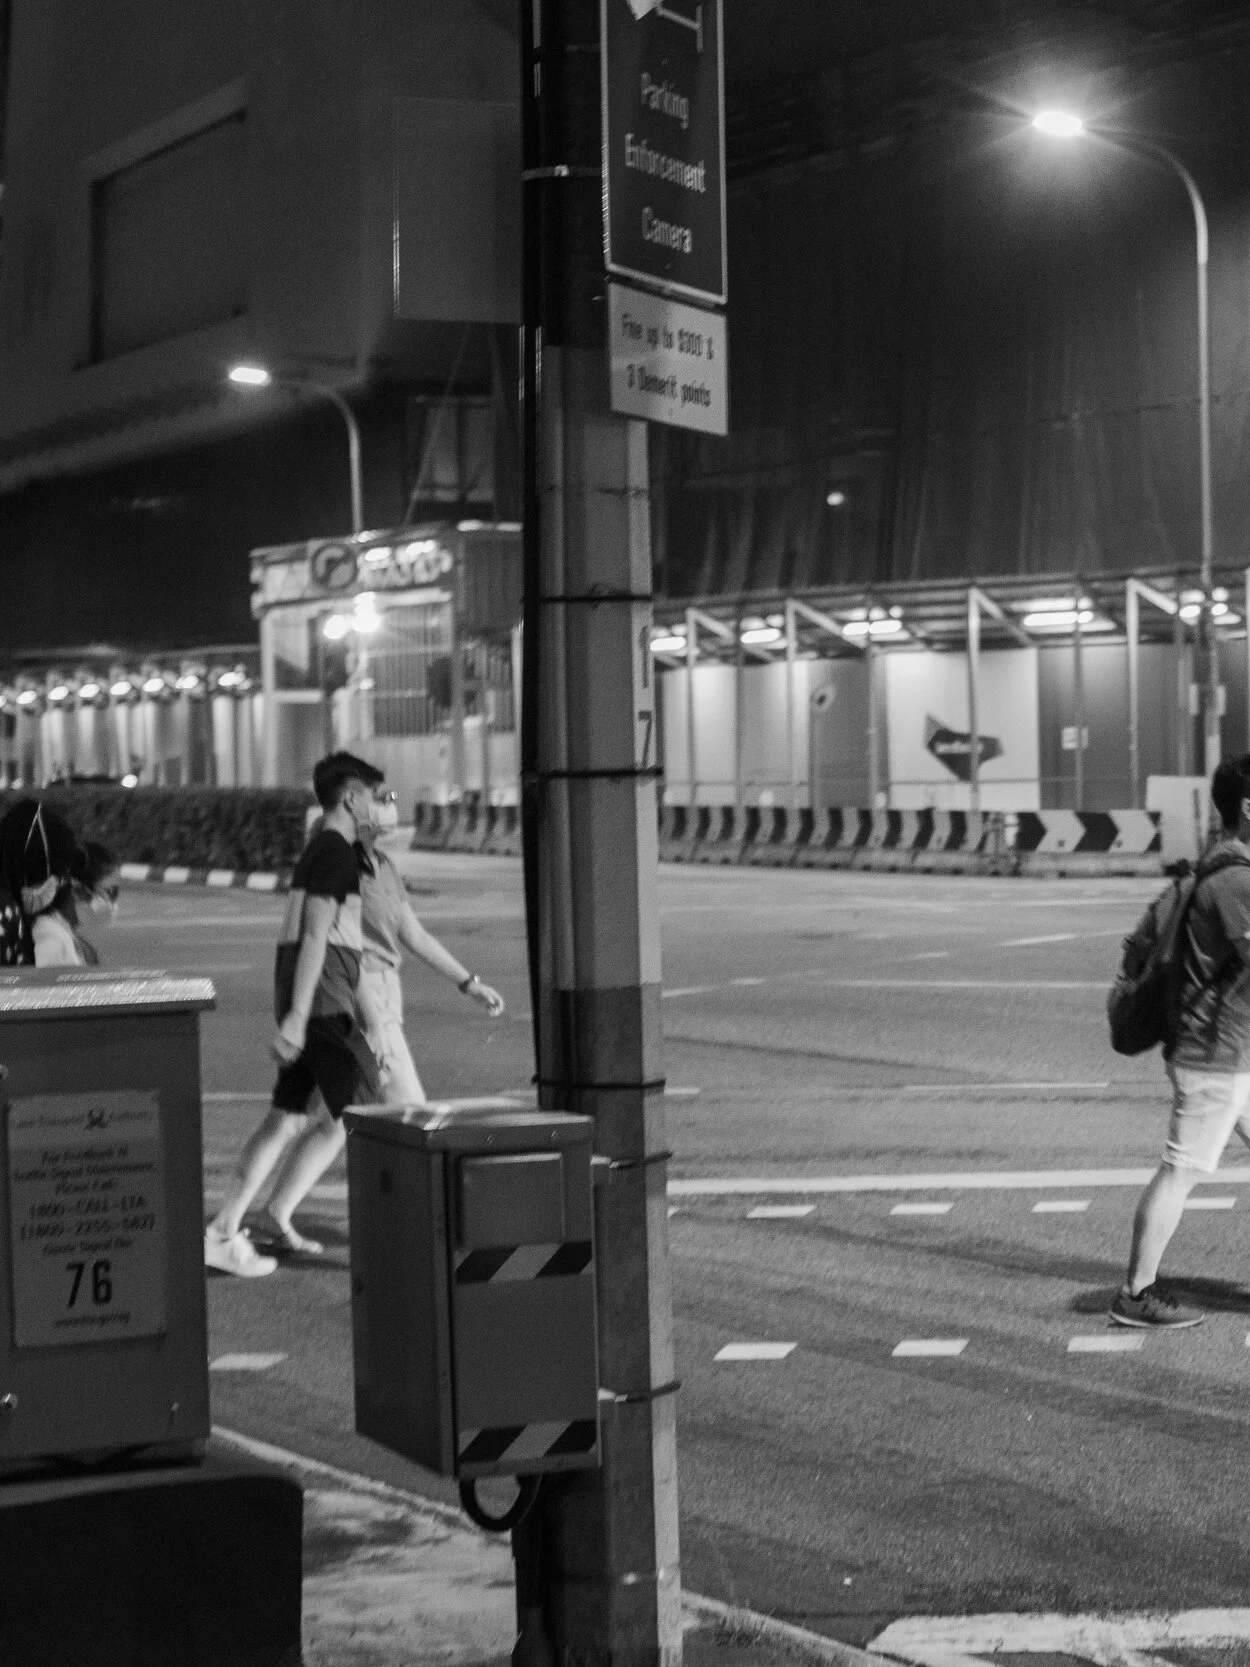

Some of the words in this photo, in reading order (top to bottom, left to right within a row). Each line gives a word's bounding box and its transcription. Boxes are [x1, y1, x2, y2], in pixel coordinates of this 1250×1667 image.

[641, 72, 689, 129] Parking
[625, 133, 705, 192] Enforcement
[642, 206, 692, 254] Camera
[646, 326, 659, 351] up
[663, 325, 674, 350] to
[681, 380, 711, 408] points
[66, 1259, 112, 1307] 76
